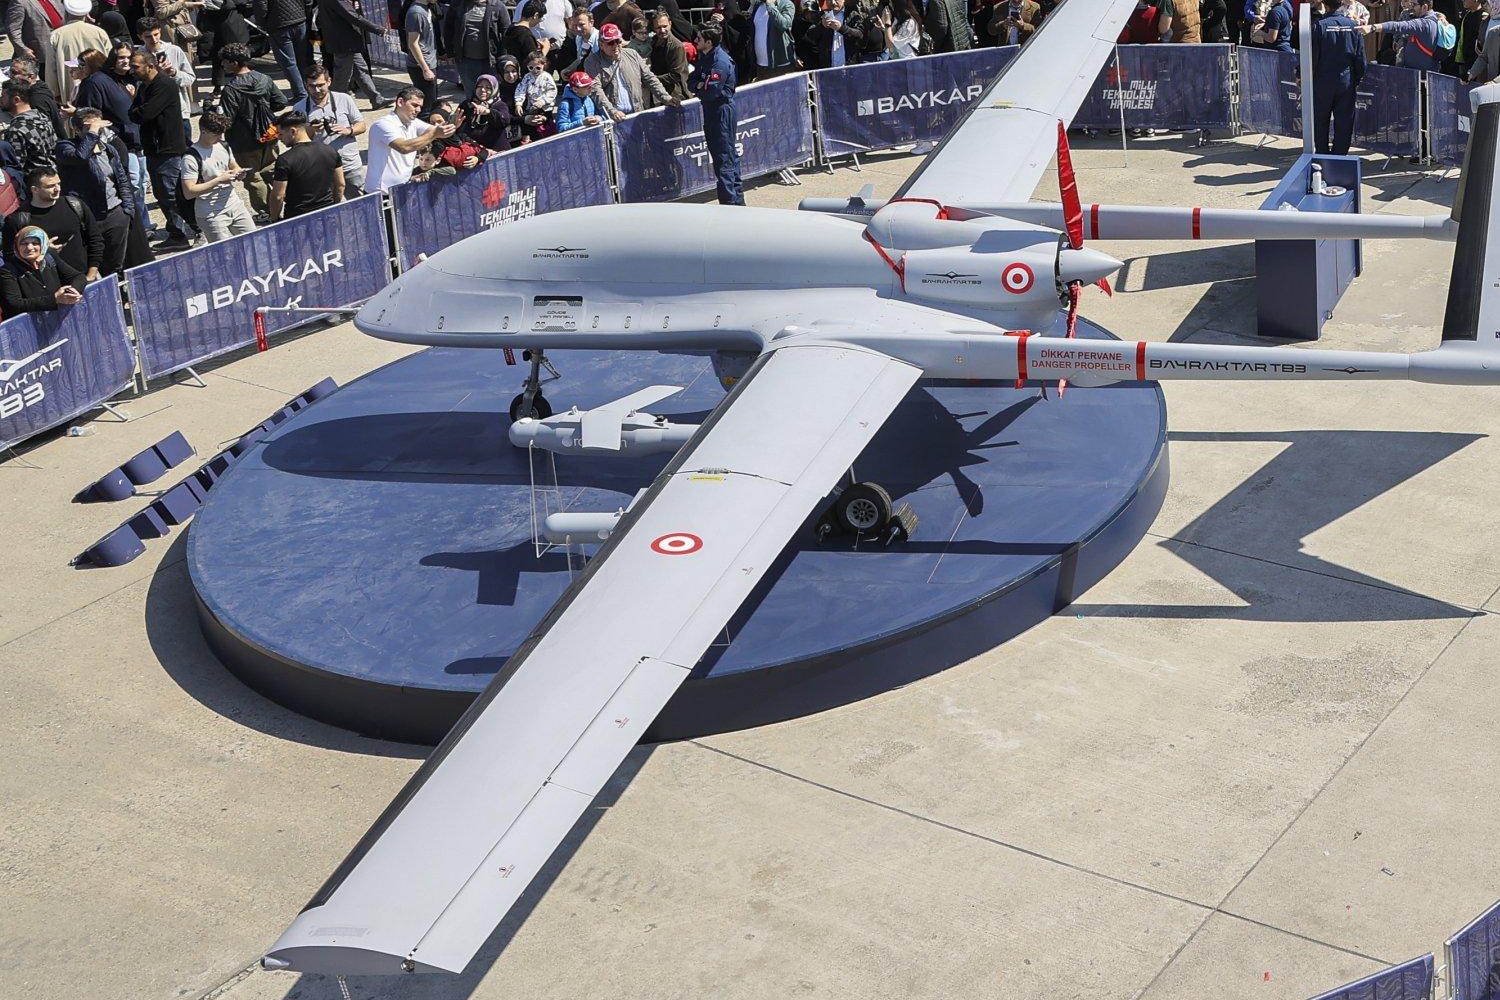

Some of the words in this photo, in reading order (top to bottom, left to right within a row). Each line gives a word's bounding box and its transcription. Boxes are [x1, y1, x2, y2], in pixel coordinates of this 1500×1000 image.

[878, 84, 983, 114] BAYKAR
[212, 249, 344, 309] BAYKAR
[1040, 348, 1075, 361] DİKKAT
[1077, 350, 1123, 361] PERVANE
[1031, 359, 1072, 370] DANGER
[1074, 360, 1132, 372] PROPELLER
[1149, 359, 1267, 372] BAYRAKTAR
